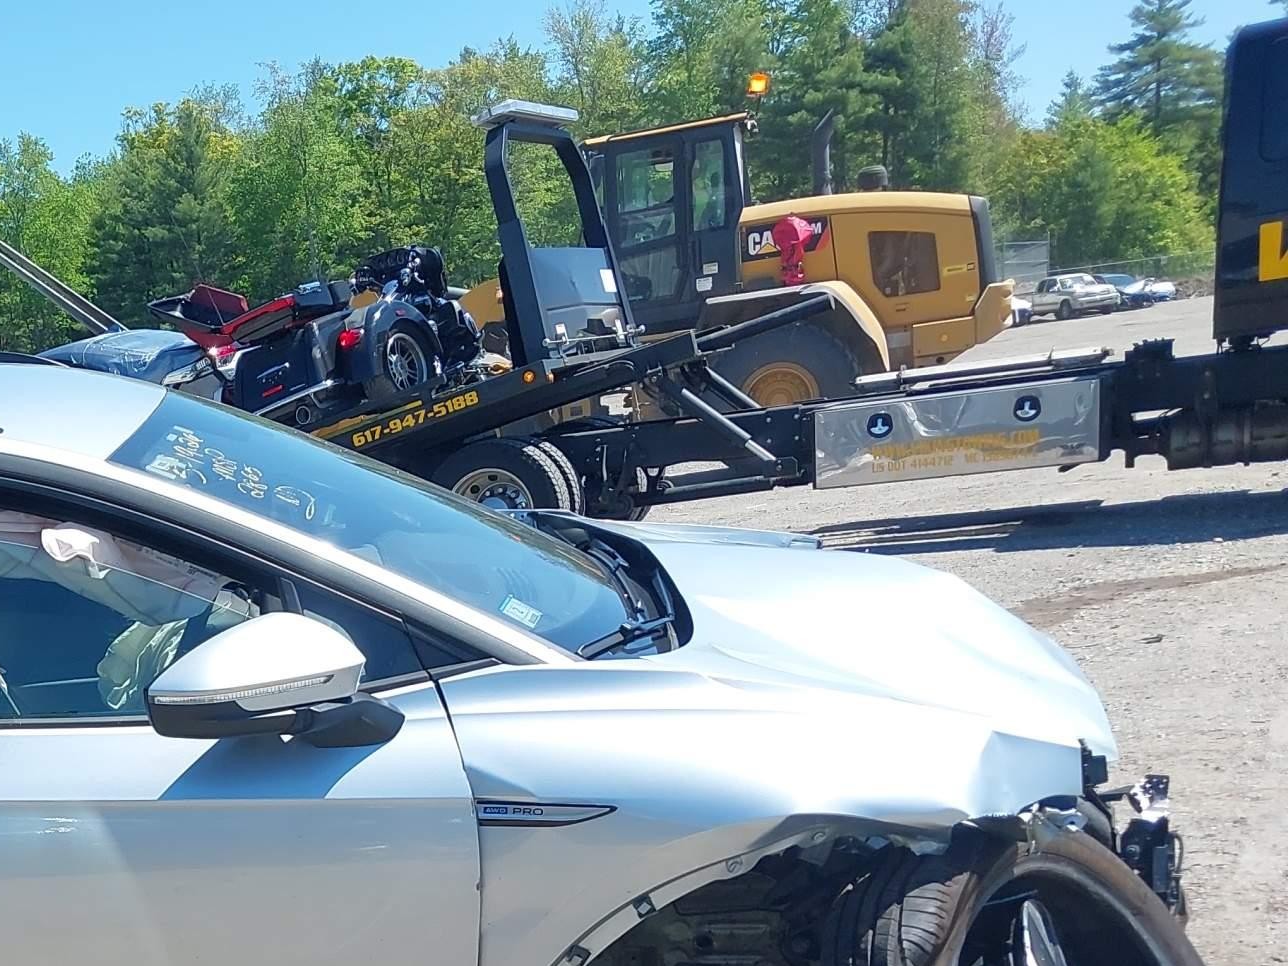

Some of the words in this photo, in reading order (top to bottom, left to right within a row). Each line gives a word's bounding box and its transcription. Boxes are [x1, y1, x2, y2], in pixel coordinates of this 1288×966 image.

[748, 230, 781, 256] CA
[352, 391, 479, 447] 617-947-5188
[512, 808, 544, 816] PRO
